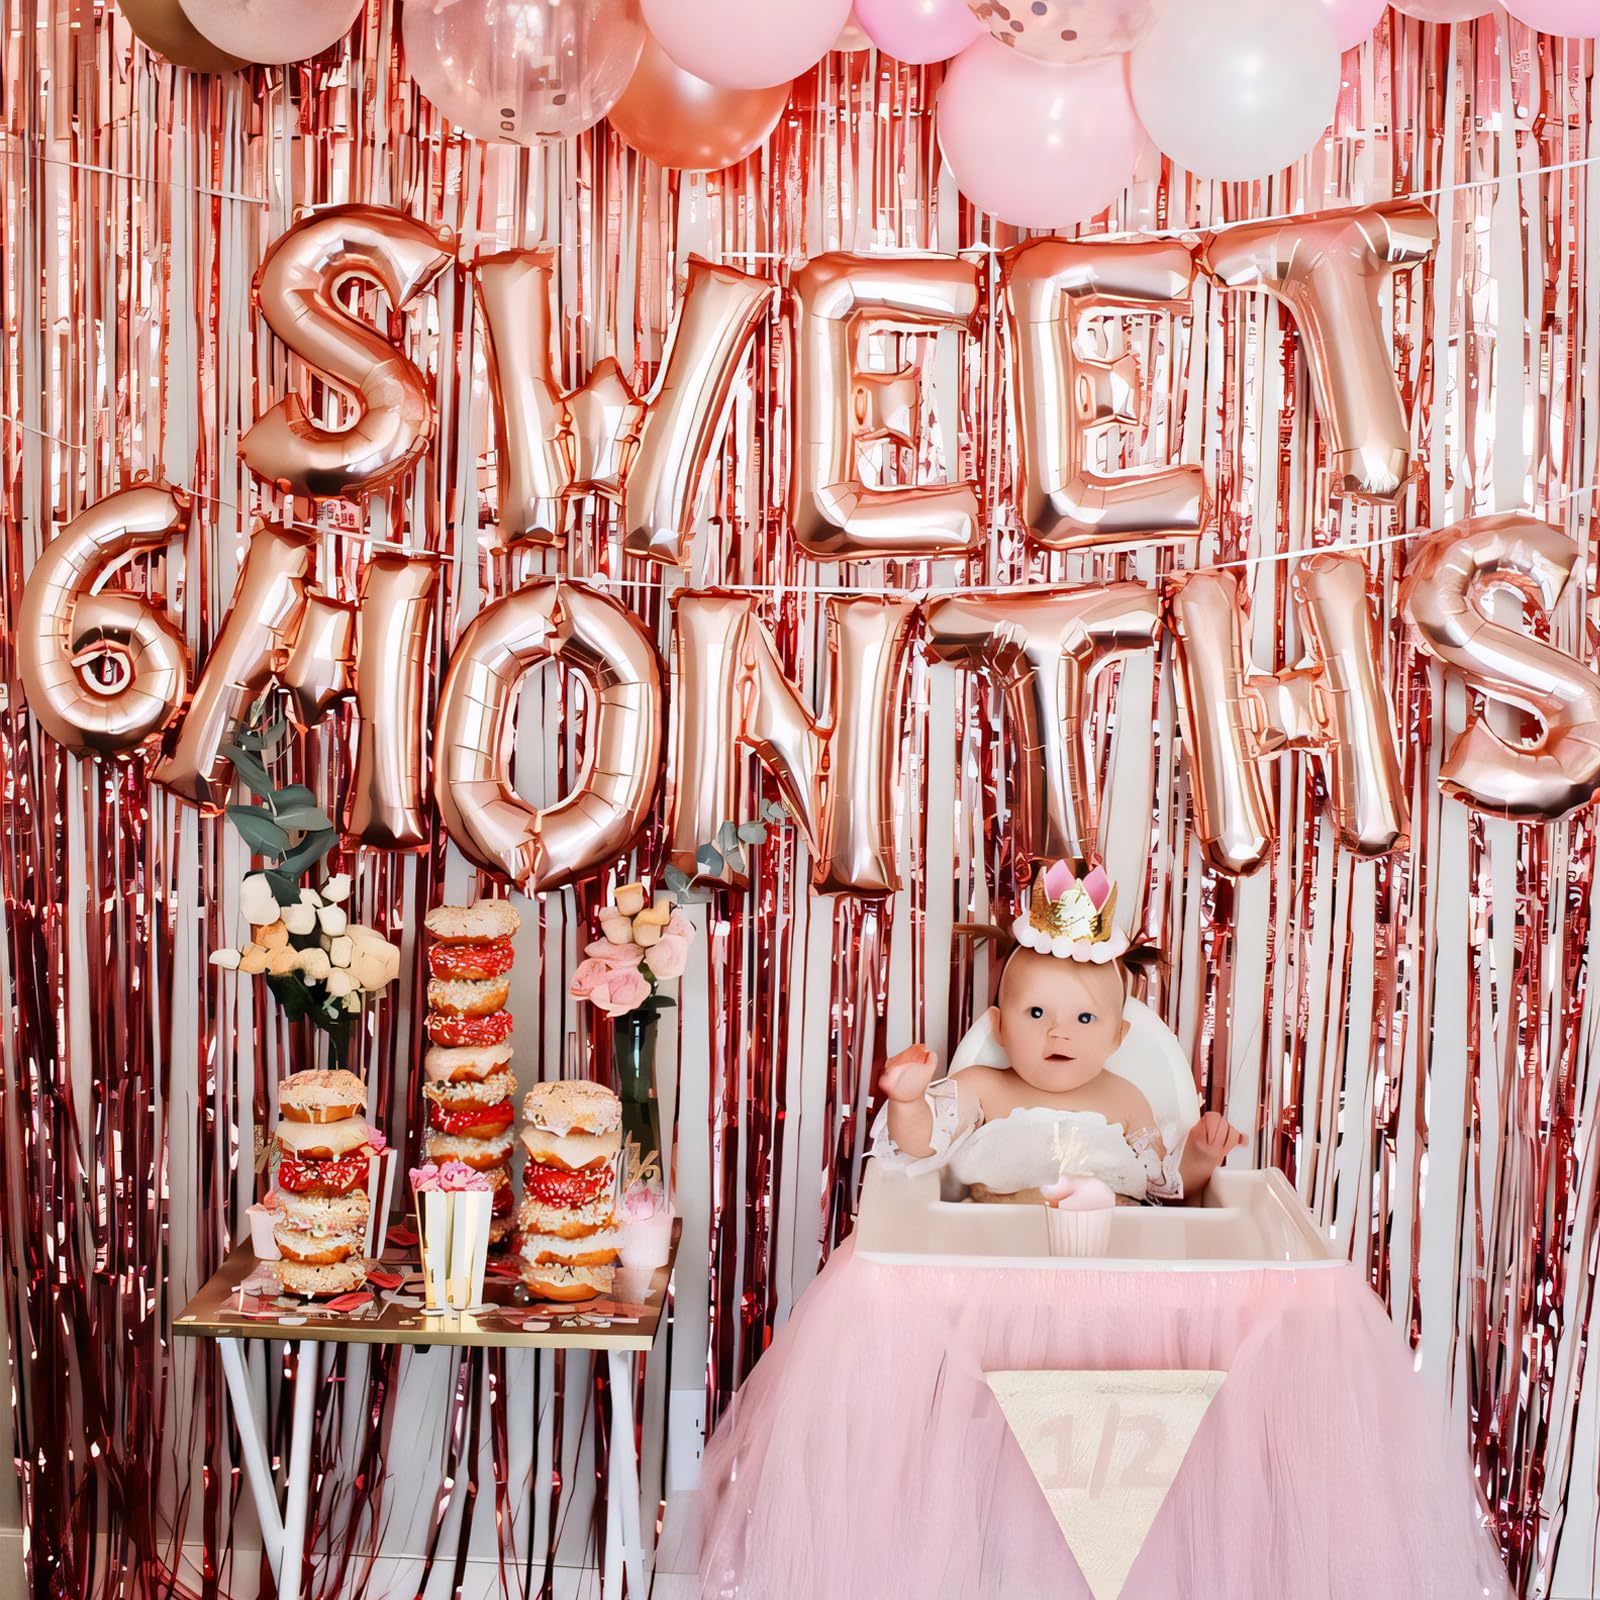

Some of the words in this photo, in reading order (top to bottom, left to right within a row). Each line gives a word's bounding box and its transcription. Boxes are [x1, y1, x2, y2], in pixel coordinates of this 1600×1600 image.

[238, 202, 1438, 563] SWEET
[18, 482, 190, 758] 6
[148, 509, 1600, 897] MONTHS
[1037, 1402, 1170, 1499] 1/2
